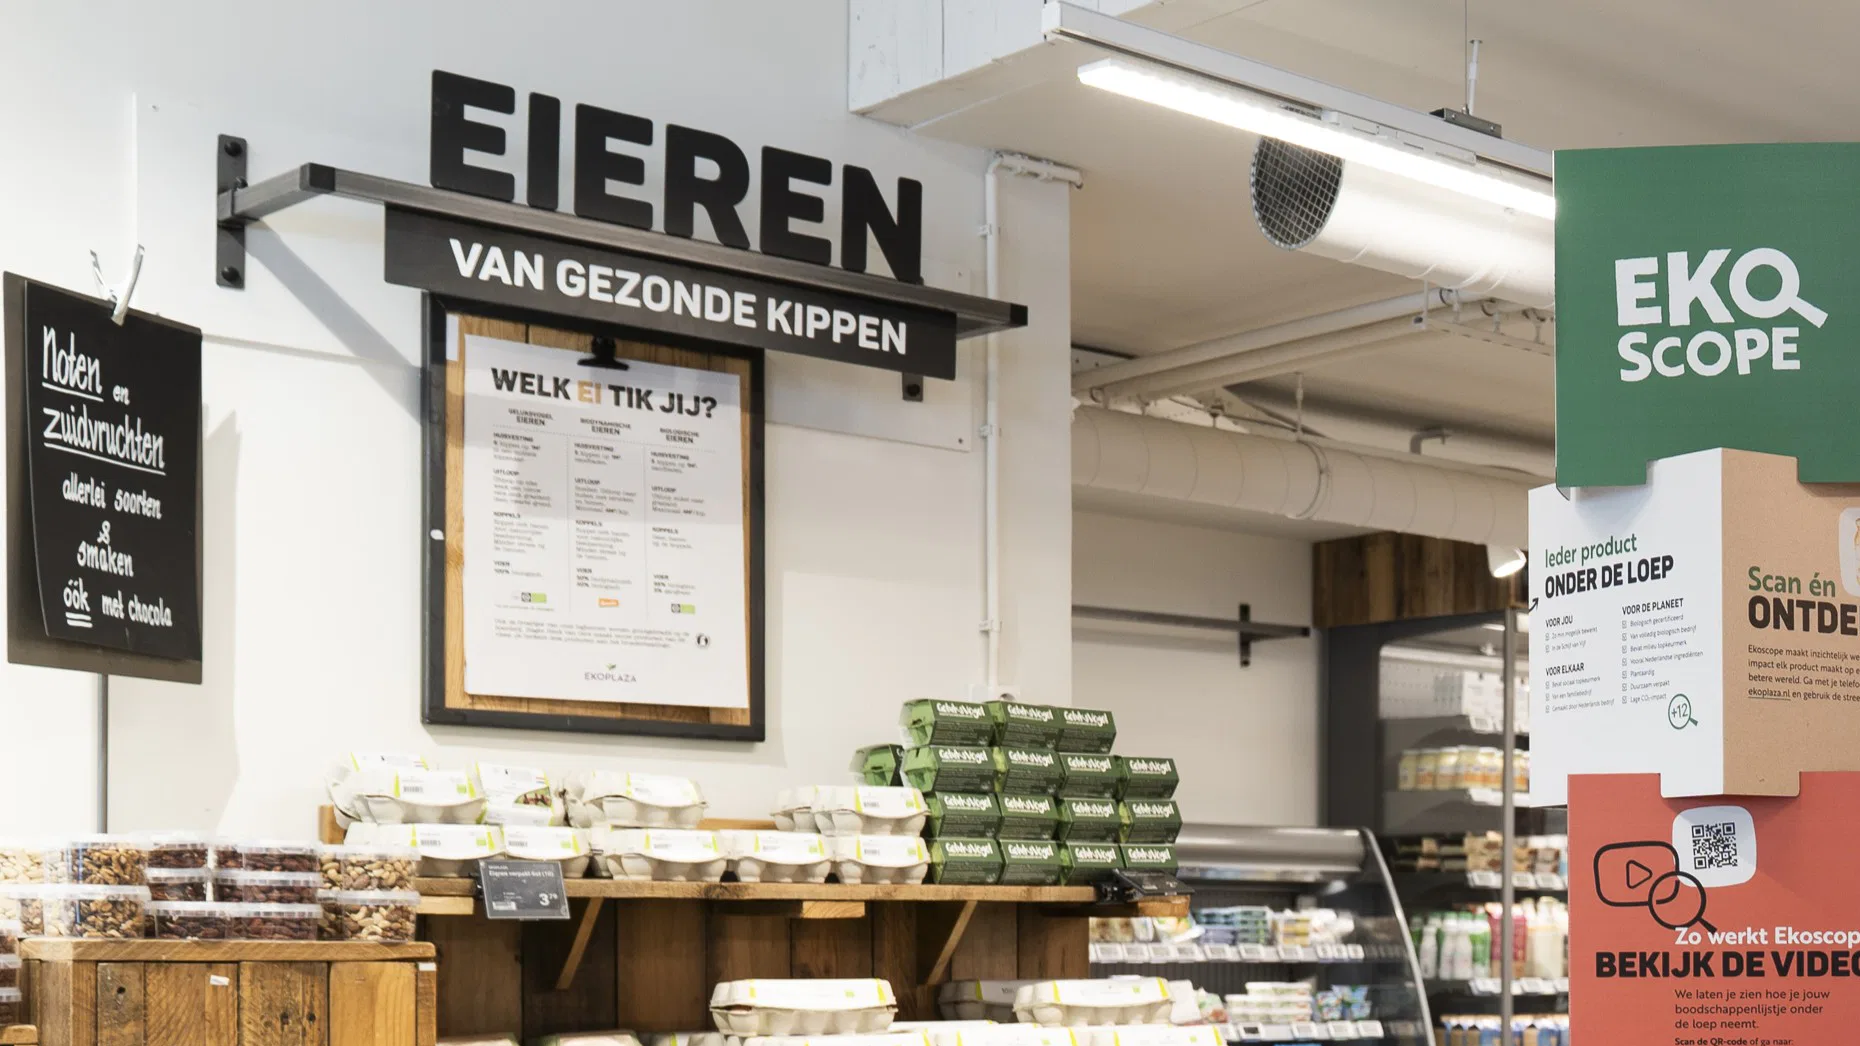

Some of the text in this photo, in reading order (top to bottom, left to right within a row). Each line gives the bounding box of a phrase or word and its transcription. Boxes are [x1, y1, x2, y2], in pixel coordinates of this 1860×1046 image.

[430, 68, 922, 284] EIEREN
[449, 238, 907, 355] VAN GEZONDE KIPPEN
[1617, 326, 1800, 382] SCOPE
[43, 326, 130, 405] Noten en
[491, 367, 718, 419] WELK EI TIK JIJ?
[516, 416, 545, 426] EIEREN
[592, 425, 621, 435] EIEREN
[666, 435, 694, 444] EIEREN
[62, 472, 162, 519] allerlei soorten
[1581, 533, 1637, 566] product
[77, 541, 134, 577] smaken
[1545, 555, 1674, 599] ONDER DE LOEP
[1748, 566, 1836, 598] Scan én
[102, 591, 125, 620] met
[129, 598, 173, 627] chocola
[1622, 598, 1684, 615] VOOR DE PLANEET
[1546, 615, 1573, 628] VOOR JOU
[1748, 644, 1783, 657] Ekoscope
[1785, 647, 1809, 658] maakt
[1810, 648, 1848, 661] inzichtelijk
[1546, 662, 1584, 676] VOOR ELKAAR
[1748, 660, 1774, 671] impact
[1776, 661, 1787, 670] elk
[1789, 662, 1819, 674] product
[1820, 664, 1843, 673] maakt
[1845, 667, 1854, 675] op
[584, 672, 637, 683] EKOPLAZA
[1748, 673, 1773, 684] betere
[1775, 675, 1801, 685] wereld.
[1803, 676, 1814, 686] Ga
[1816, 678, 1829, 687] met
[1831, 679, 1837, 689] je
[1748, 688, 1791, 699] ekoplaza.nl
[1792, 691, 1802, 699] en
[1803, 691, 1830, 701] gebruik
[1832, 692, 1841, 701] de
[1671, 703, 1688, 718] +12
[1675, 927, 1701, 945] Zo
[1708, 927, 1768, 946] werkt
[1596, 952, 1715, 978] BEKIJK
[1722, 951, 1765, 978] DE
[1675, 989, 1831, 1002] We laten je zien hoe je jouw
[1675, 1003, 1824, 1016] boodschappenlijstje onder
[1675, 1018, 1759, 1032] de loep neemt.
[1675, 1038, 1695, 1046] Scan
[1697, 1037, 1708, 1046] de
[1710, 1037, 1748, 1046] QR-code
[1749, 1037, 1758, 1046] of
